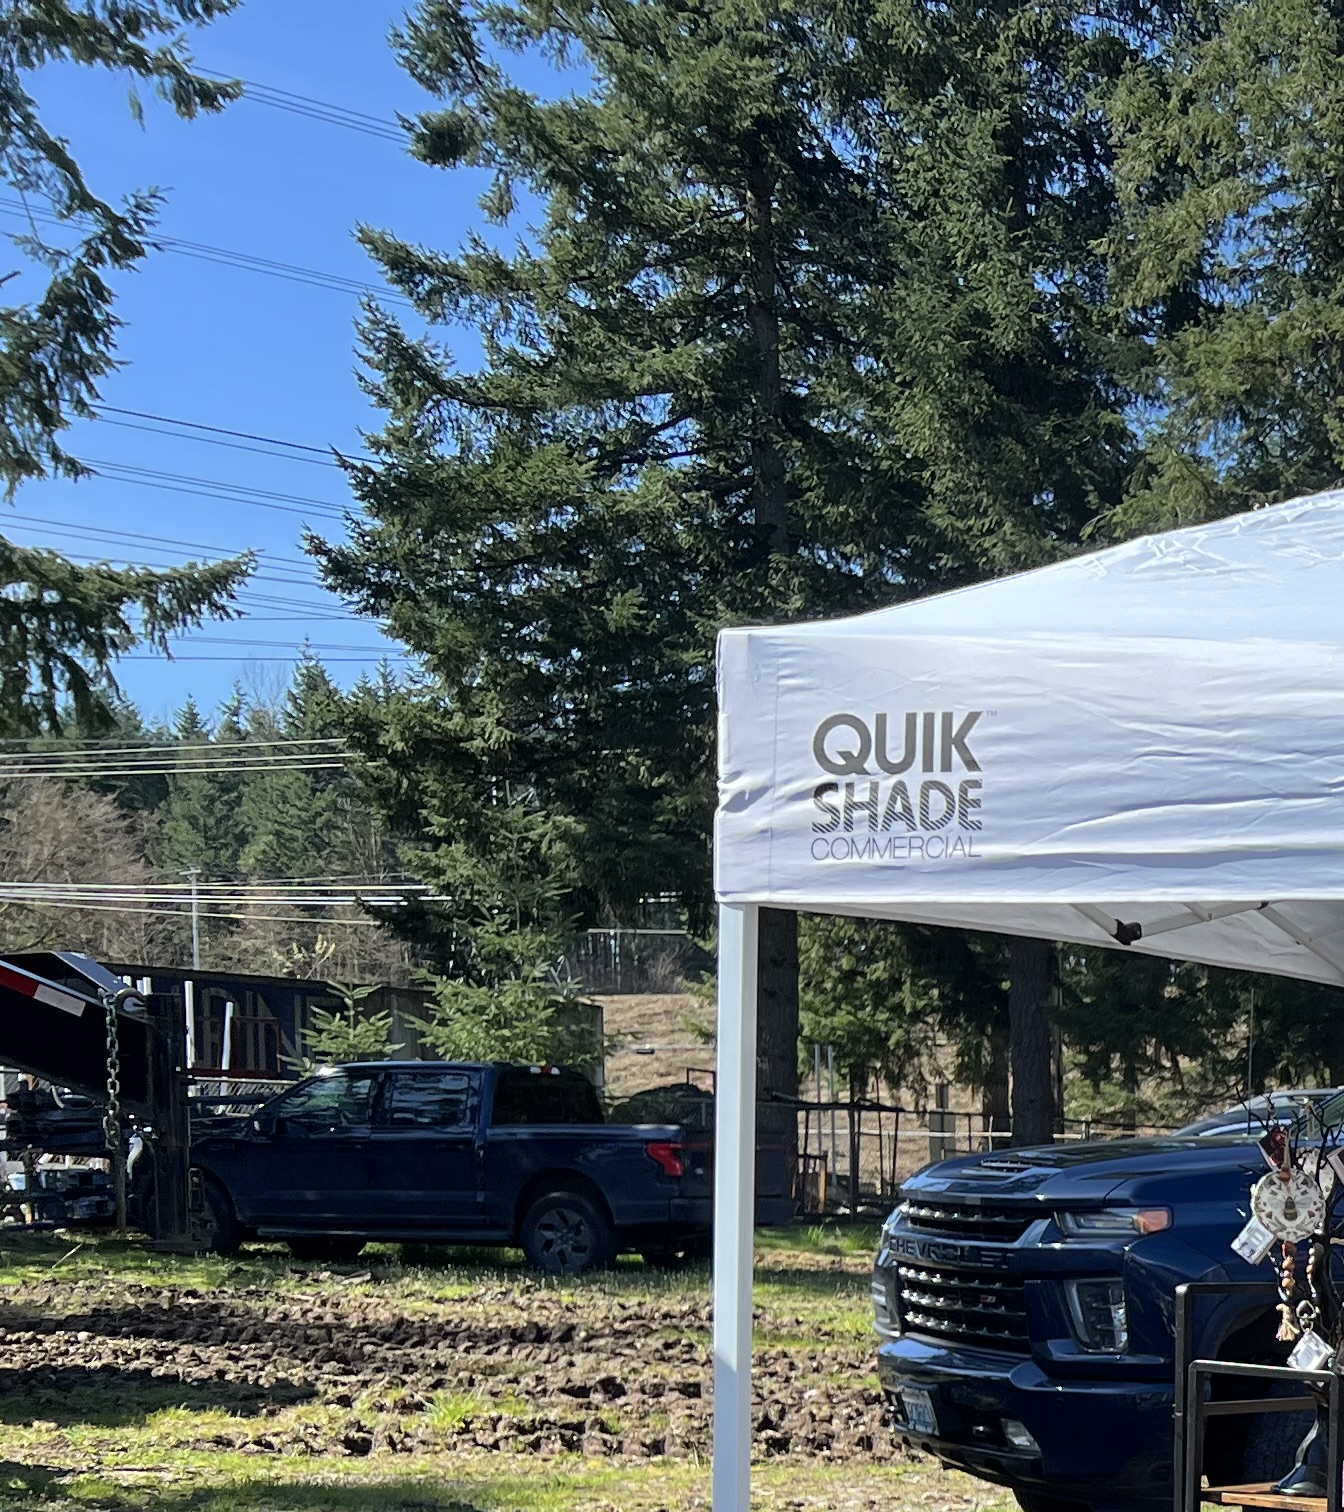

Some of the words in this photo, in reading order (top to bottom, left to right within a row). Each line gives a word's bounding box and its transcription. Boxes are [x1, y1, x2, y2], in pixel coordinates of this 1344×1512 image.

[813, 711, 983, 776] QUIK
[812, 779, 984, 834] SHADE
[810, 836, 982, 861] COMMERCIAL
